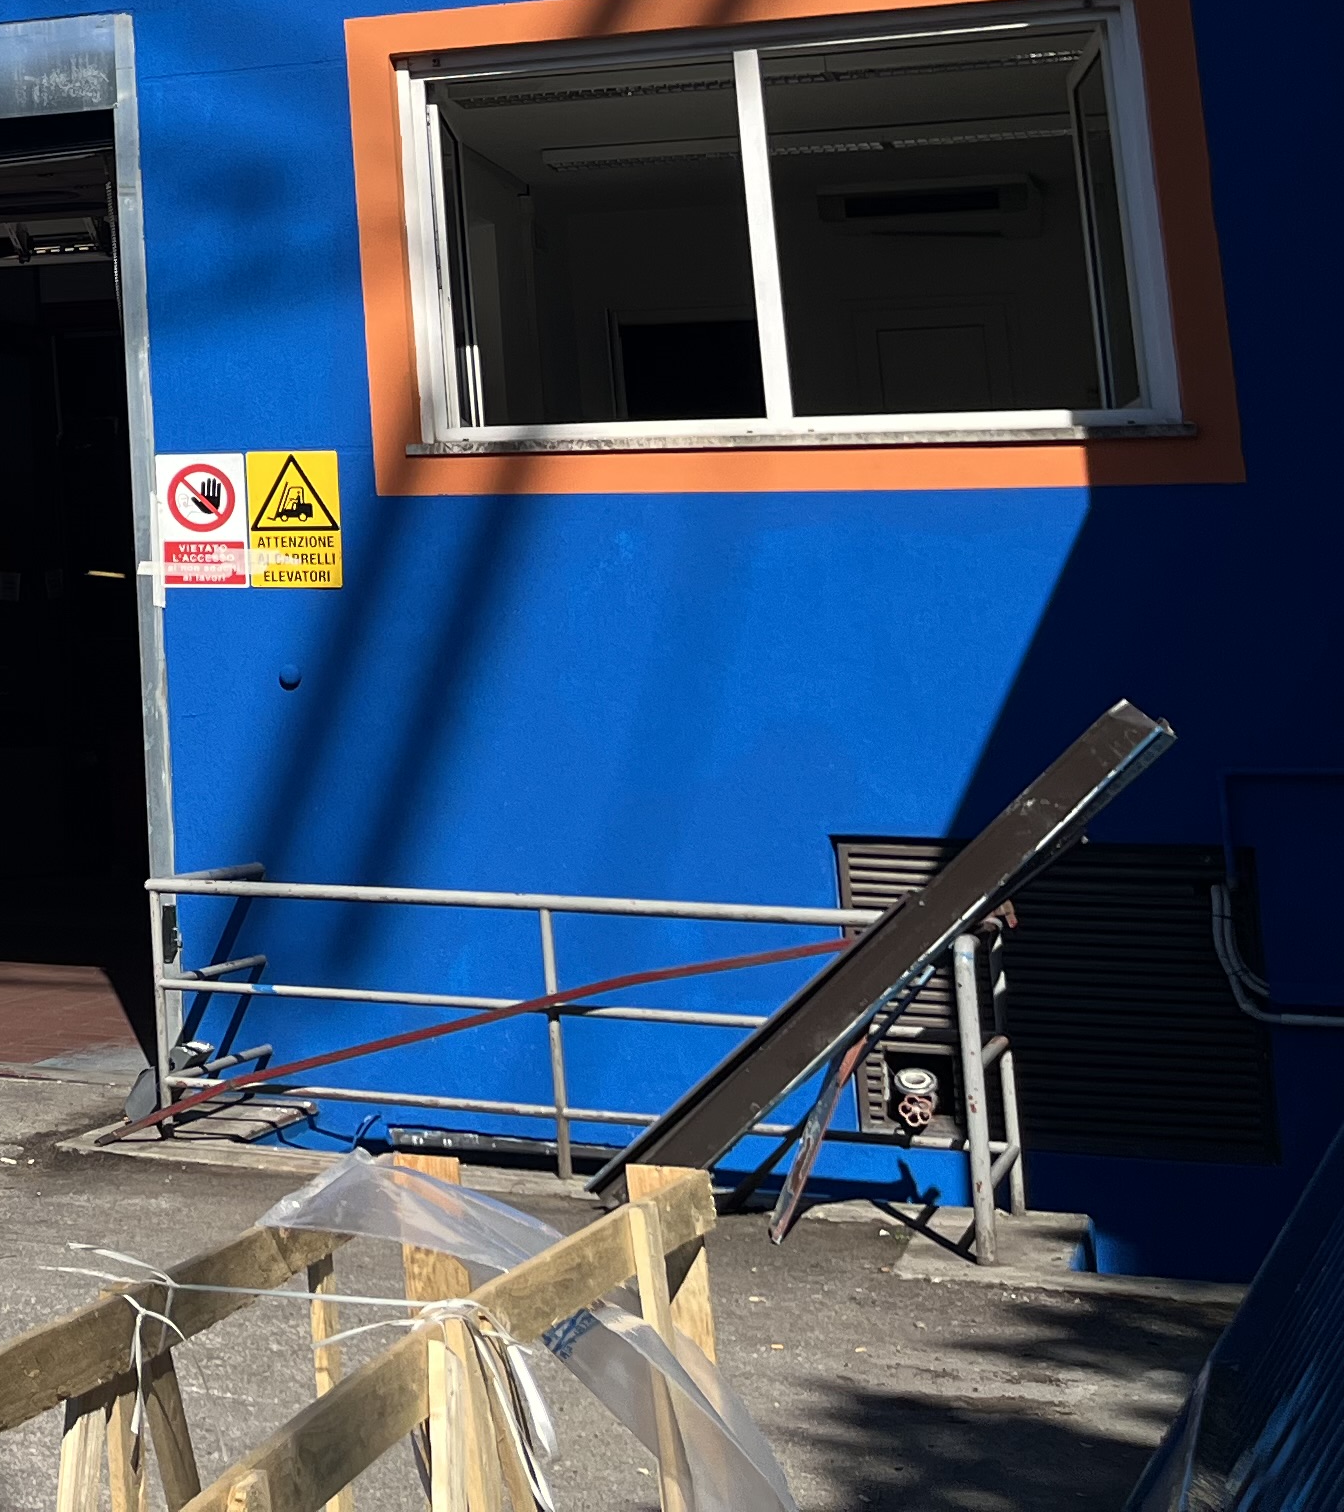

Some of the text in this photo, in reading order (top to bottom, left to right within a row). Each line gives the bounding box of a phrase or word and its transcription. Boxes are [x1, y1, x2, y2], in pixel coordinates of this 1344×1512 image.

[258, 536, 334, 548] ATTENZIONE
[178, 544, 228, 553] VIETATO
[172, 553, 235, 562] L'ACCESSO
[264, 570, 330, 582] ELEVATORI
